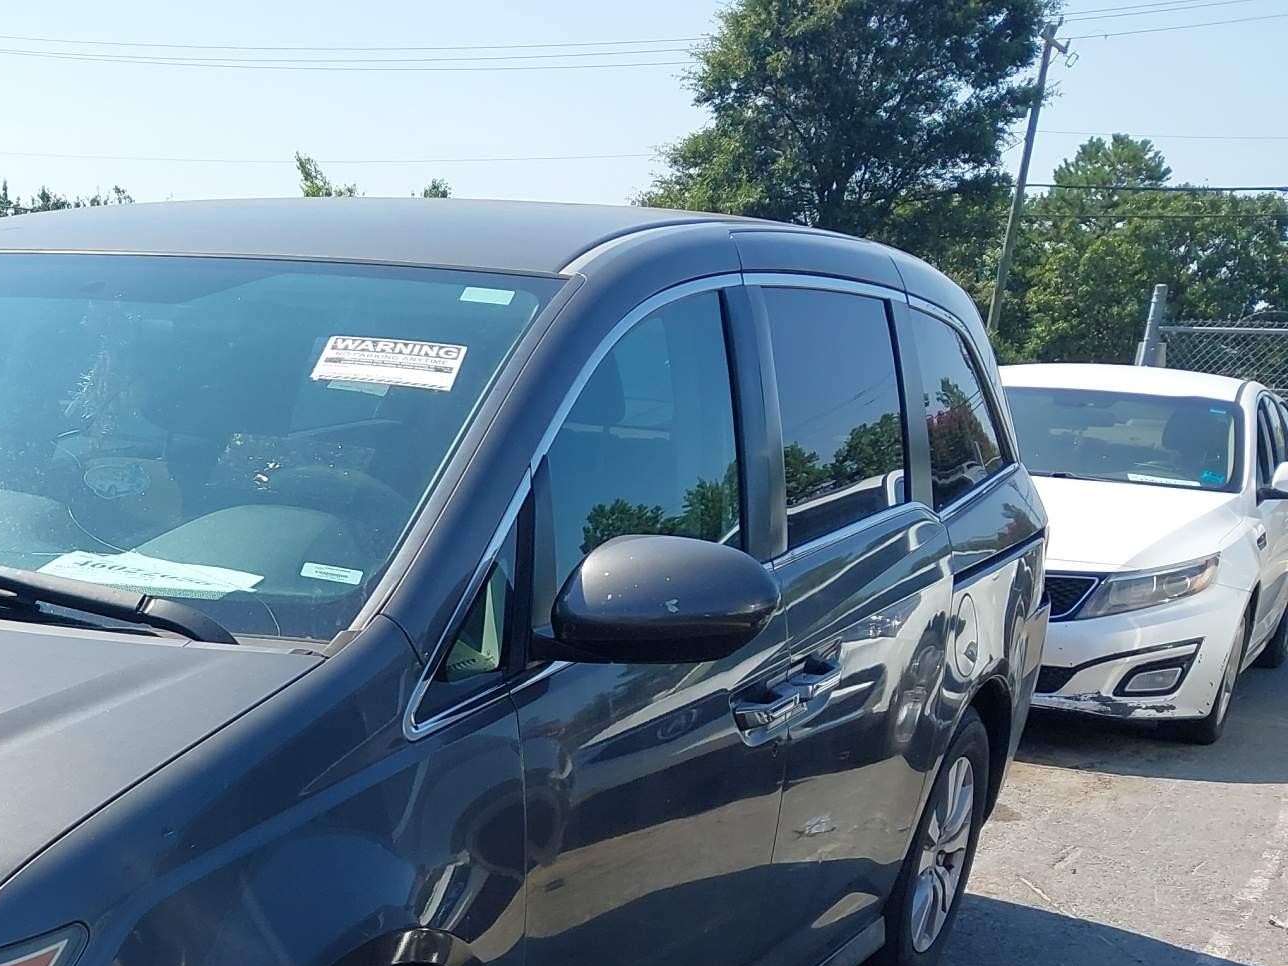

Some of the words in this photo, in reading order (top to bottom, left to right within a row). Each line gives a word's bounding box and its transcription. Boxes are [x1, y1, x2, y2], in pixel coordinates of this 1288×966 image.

[334, 338, 459, 358] WARNING
[352, 351, 399, 360] PARKING
[402, 356, 449, 365] ANYTIME
